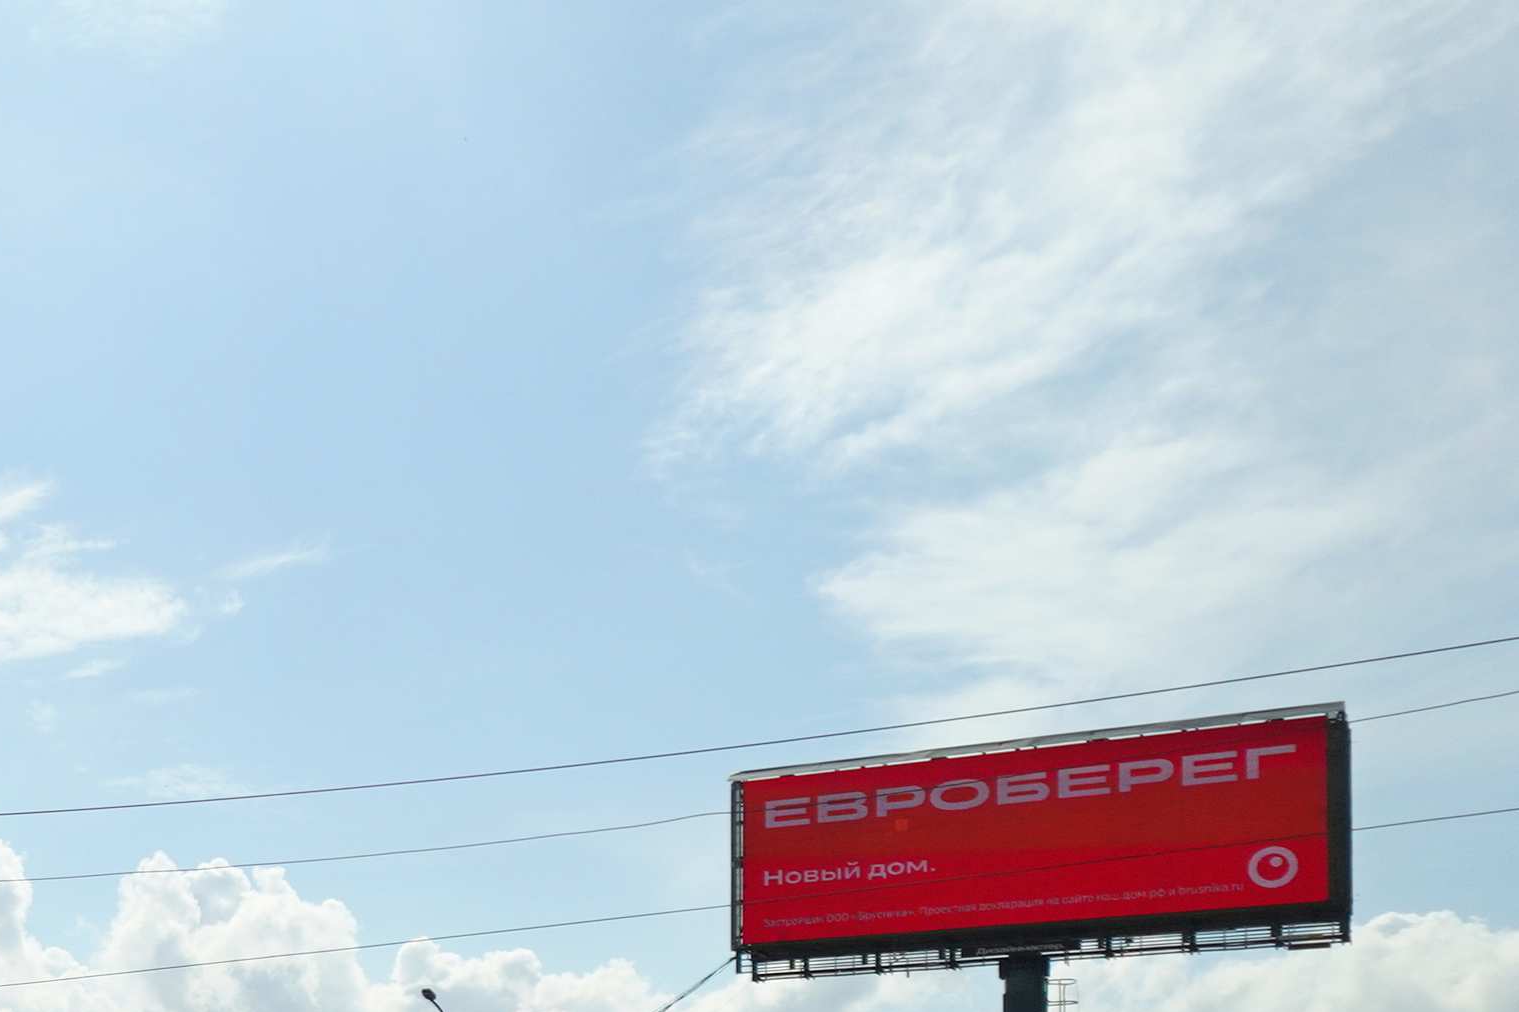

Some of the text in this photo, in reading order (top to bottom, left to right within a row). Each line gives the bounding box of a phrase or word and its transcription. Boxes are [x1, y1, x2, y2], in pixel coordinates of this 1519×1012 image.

[764, 744, 1297, 829] ЕВРОБЕРЕГ
[763, 859, 936, 887] Новый дом.
[826, 911, 850, 923] ООО
